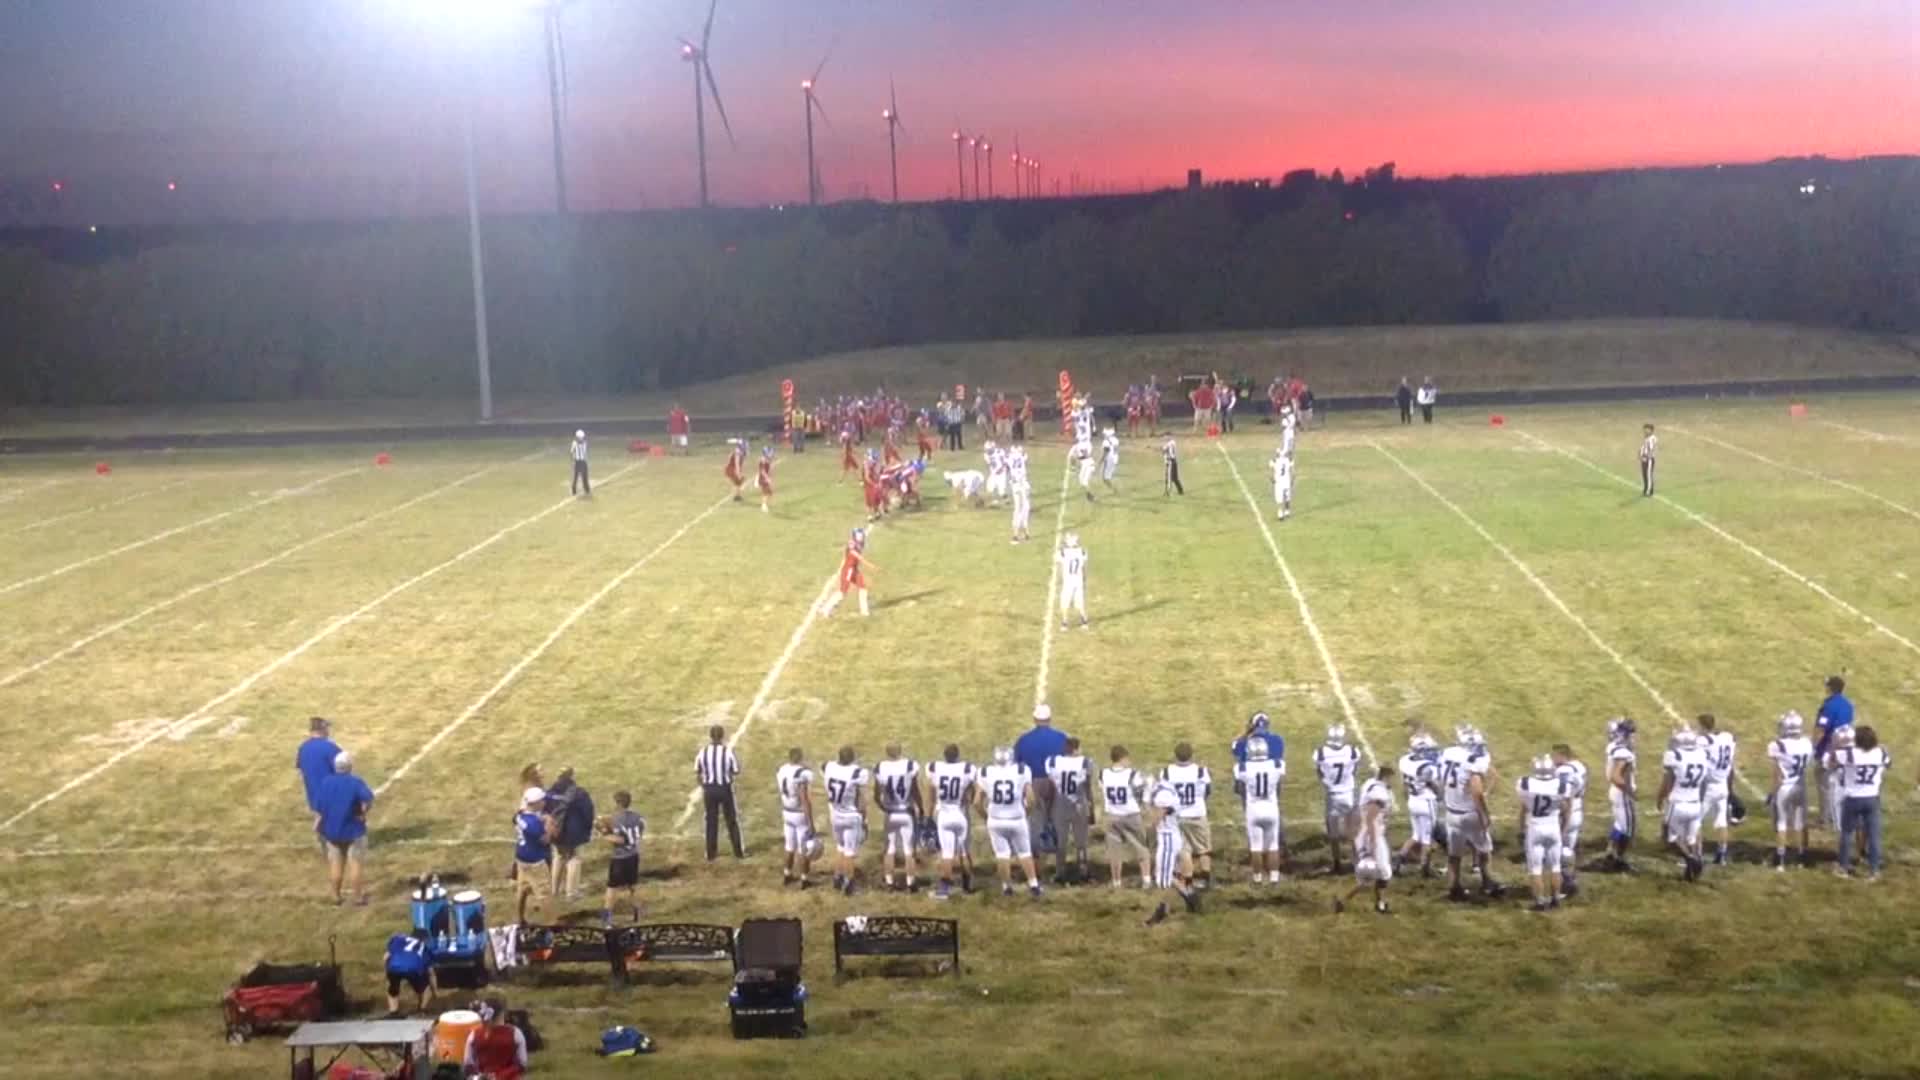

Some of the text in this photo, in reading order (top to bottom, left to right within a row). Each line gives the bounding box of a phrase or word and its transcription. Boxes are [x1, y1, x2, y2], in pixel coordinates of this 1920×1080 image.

[1061, 770, 1077, 794] 16
[1255, 772, 1269, 799] 11
[1333, 763, 1344, 784] 7
[828, 778, 846, 804] 57
[939, 776, 961, 800] 50
[993, 780, 1014, 804] 63
[1532, 795, 1552, 817] 12
